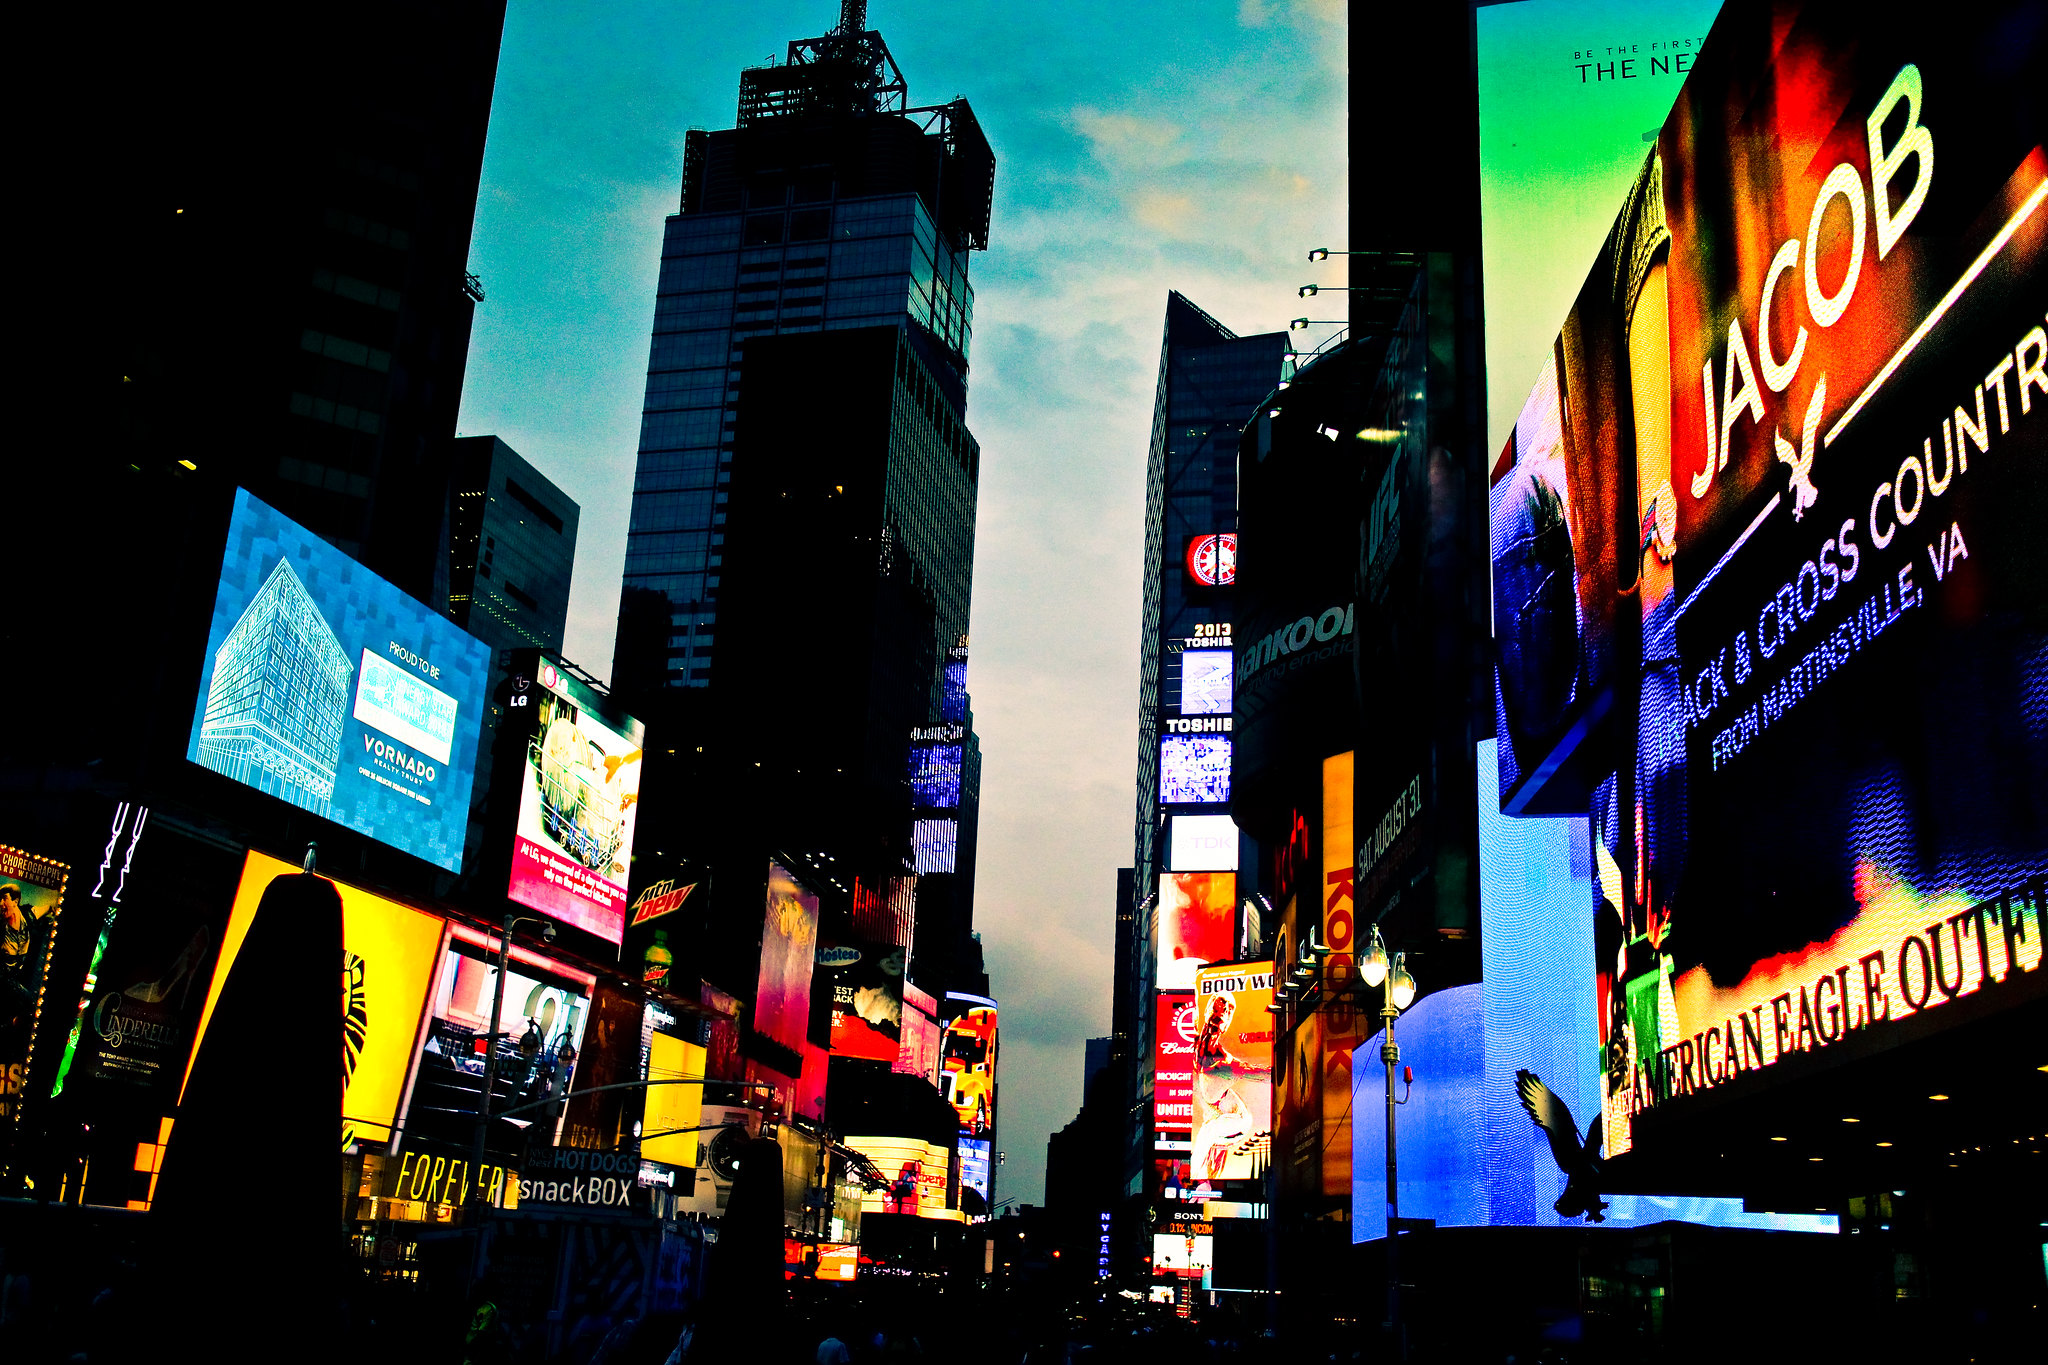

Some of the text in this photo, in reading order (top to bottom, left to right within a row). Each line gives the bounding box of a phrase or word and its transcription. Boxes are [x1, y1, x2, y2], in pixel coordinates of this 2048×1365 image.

[1574, 37, 1704, 60] BE THE FIRST
[1575, 52, 1700, 83] THE NE
[1691, 64, 1935, 499] JACOB
[1758, 518, 1859, 659] CROSS
[1869, 312, 2048, 550] COUNTR
[1184, 636, 1234, 648] TOSHIB
[1194, 622, 1232, 637] 2013
[1712, 702, 1760, 772] FROM
[1927, 520, 1969, 582] VA
[389, 640, 441, 681] PROUD TO BE
[510, 694, 528, 707] LG
[364, 733, 436, 783] VORNADO
[373, 757, 424, 787] REALTY TRUST
[1374, 789, 1408, 864] AUGUST
[1409, 772, 1422, 819] 31
[520, 842, 529, 856] At
[2, 853, 62, 882] CHOREOGRAPHY
[815, 947, 860, 963] Hostess
[1202, 976, 1248, 995] BODY
[1630, 1004, 1764, 1117] AMERICAN
[1770, 950, 1893, 1055] EAGLE
[1156, 1072, 1192, 1081] BROUGHT
[1157, 1103, 1193, 1117] UNITE
[553, 1150, 639, 1175] HOT DOGS
[1173, 1212, 1204, 1221] SONY
